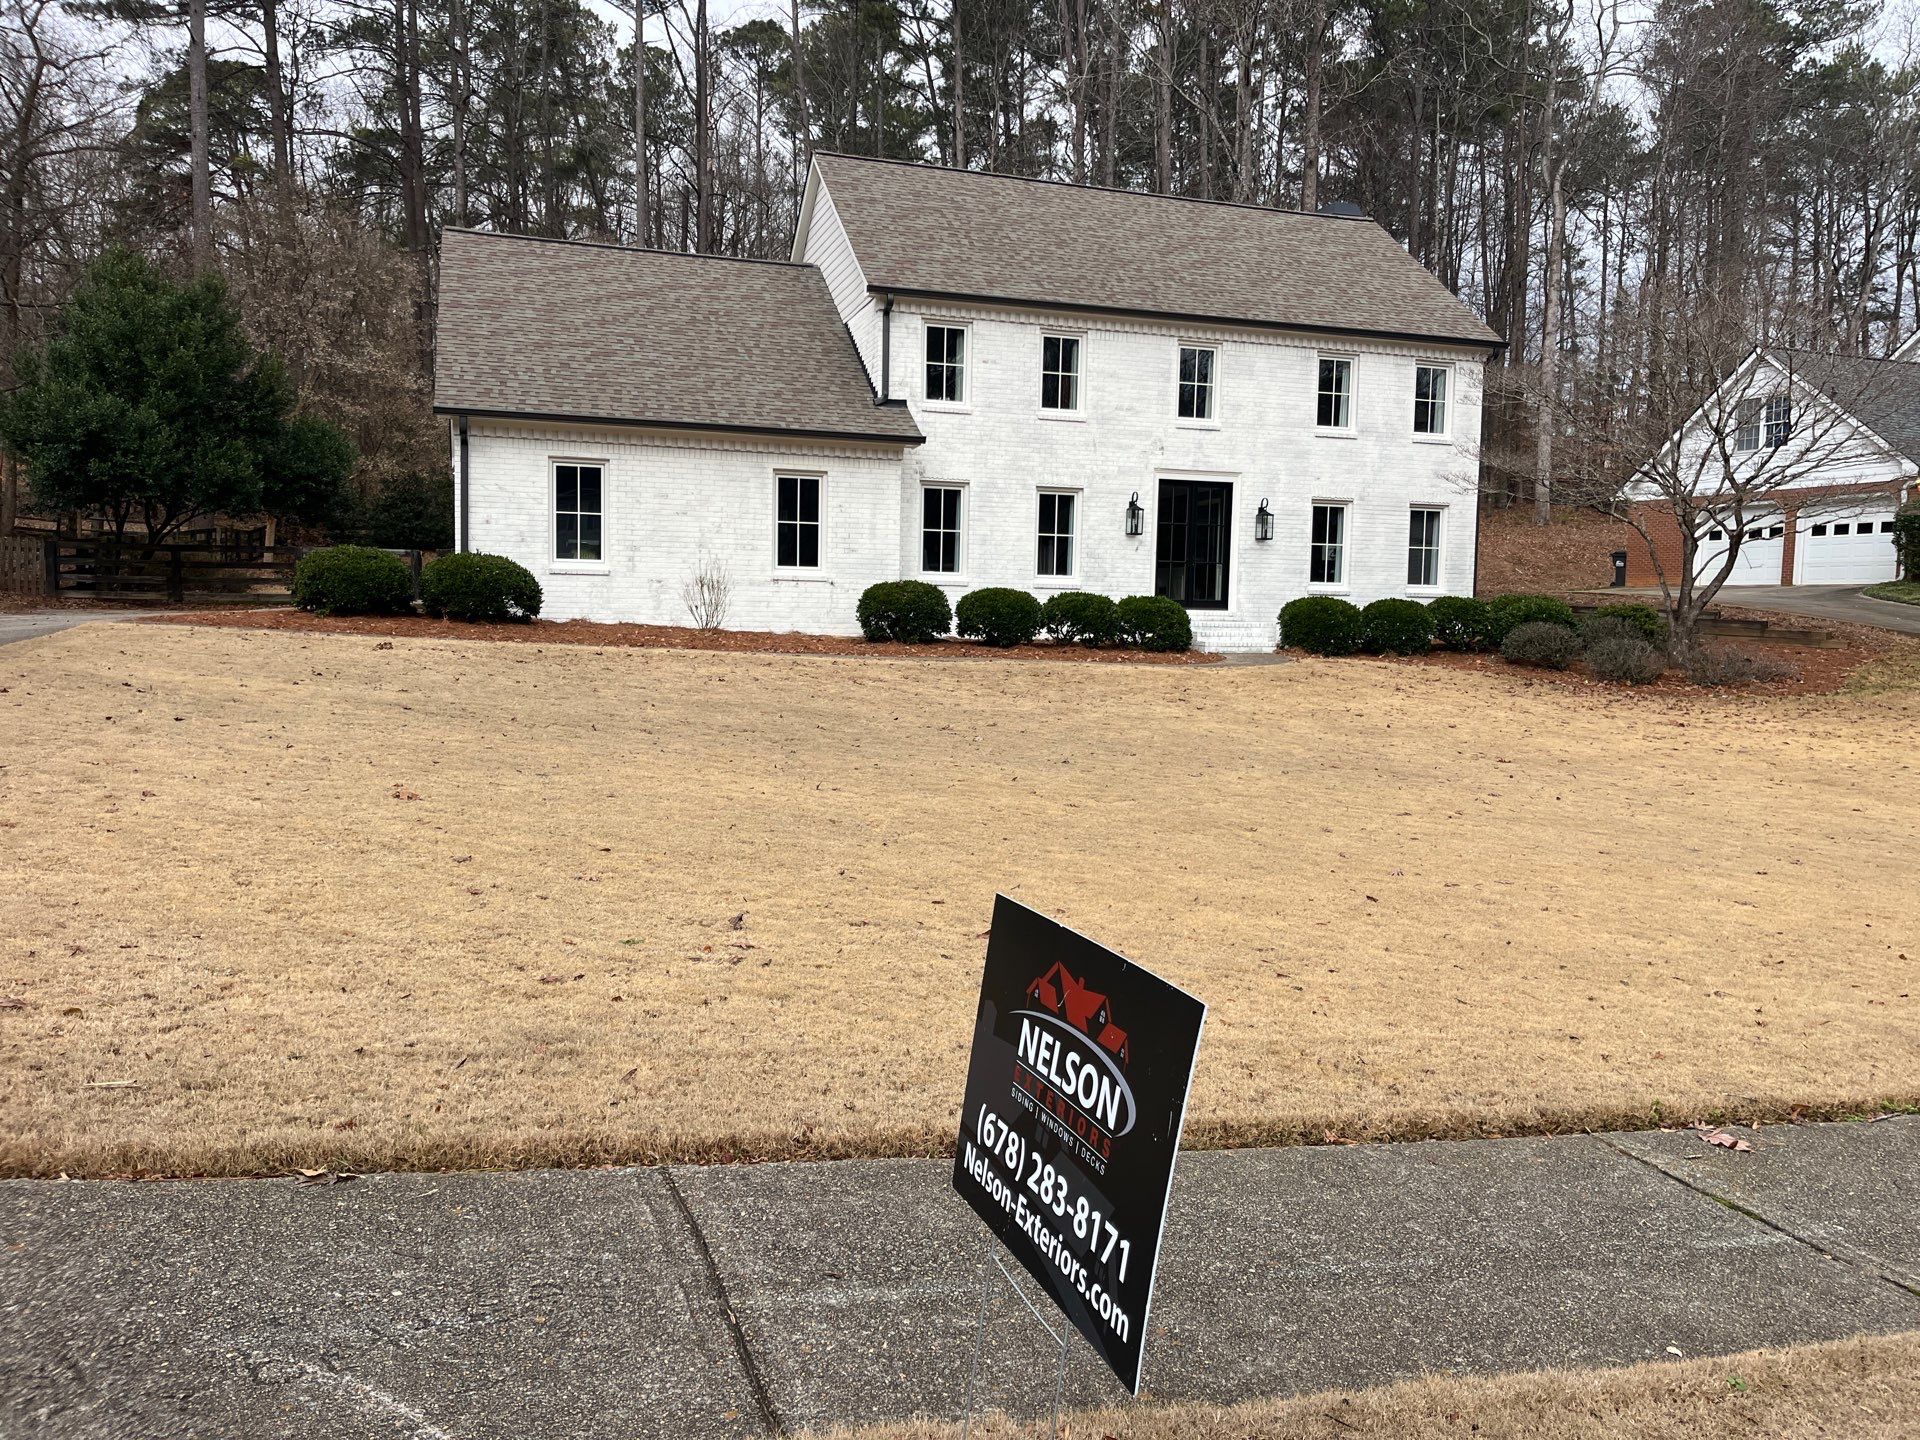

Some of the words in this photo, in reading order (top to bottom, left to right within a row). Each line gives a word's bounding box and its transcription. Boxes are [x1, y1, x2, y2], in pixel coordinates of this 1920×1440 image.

[1013, 1065, 1111, 1159] EXTERIORS
[1017, 1017, 1122, 1131] NELSON
[1011, 1087, 1034, 1112] SIDING
[1041, 1113, 1074, 1147] WINDOWS
[1080, 1147, 1106, 1176] DECKS
[963, 1141, 1129, 1344] Nelson-Exteriors.com
[976, 1103, 1025, 1182] (678)
[1026, 1151, 1130, 1284] 283-8171
